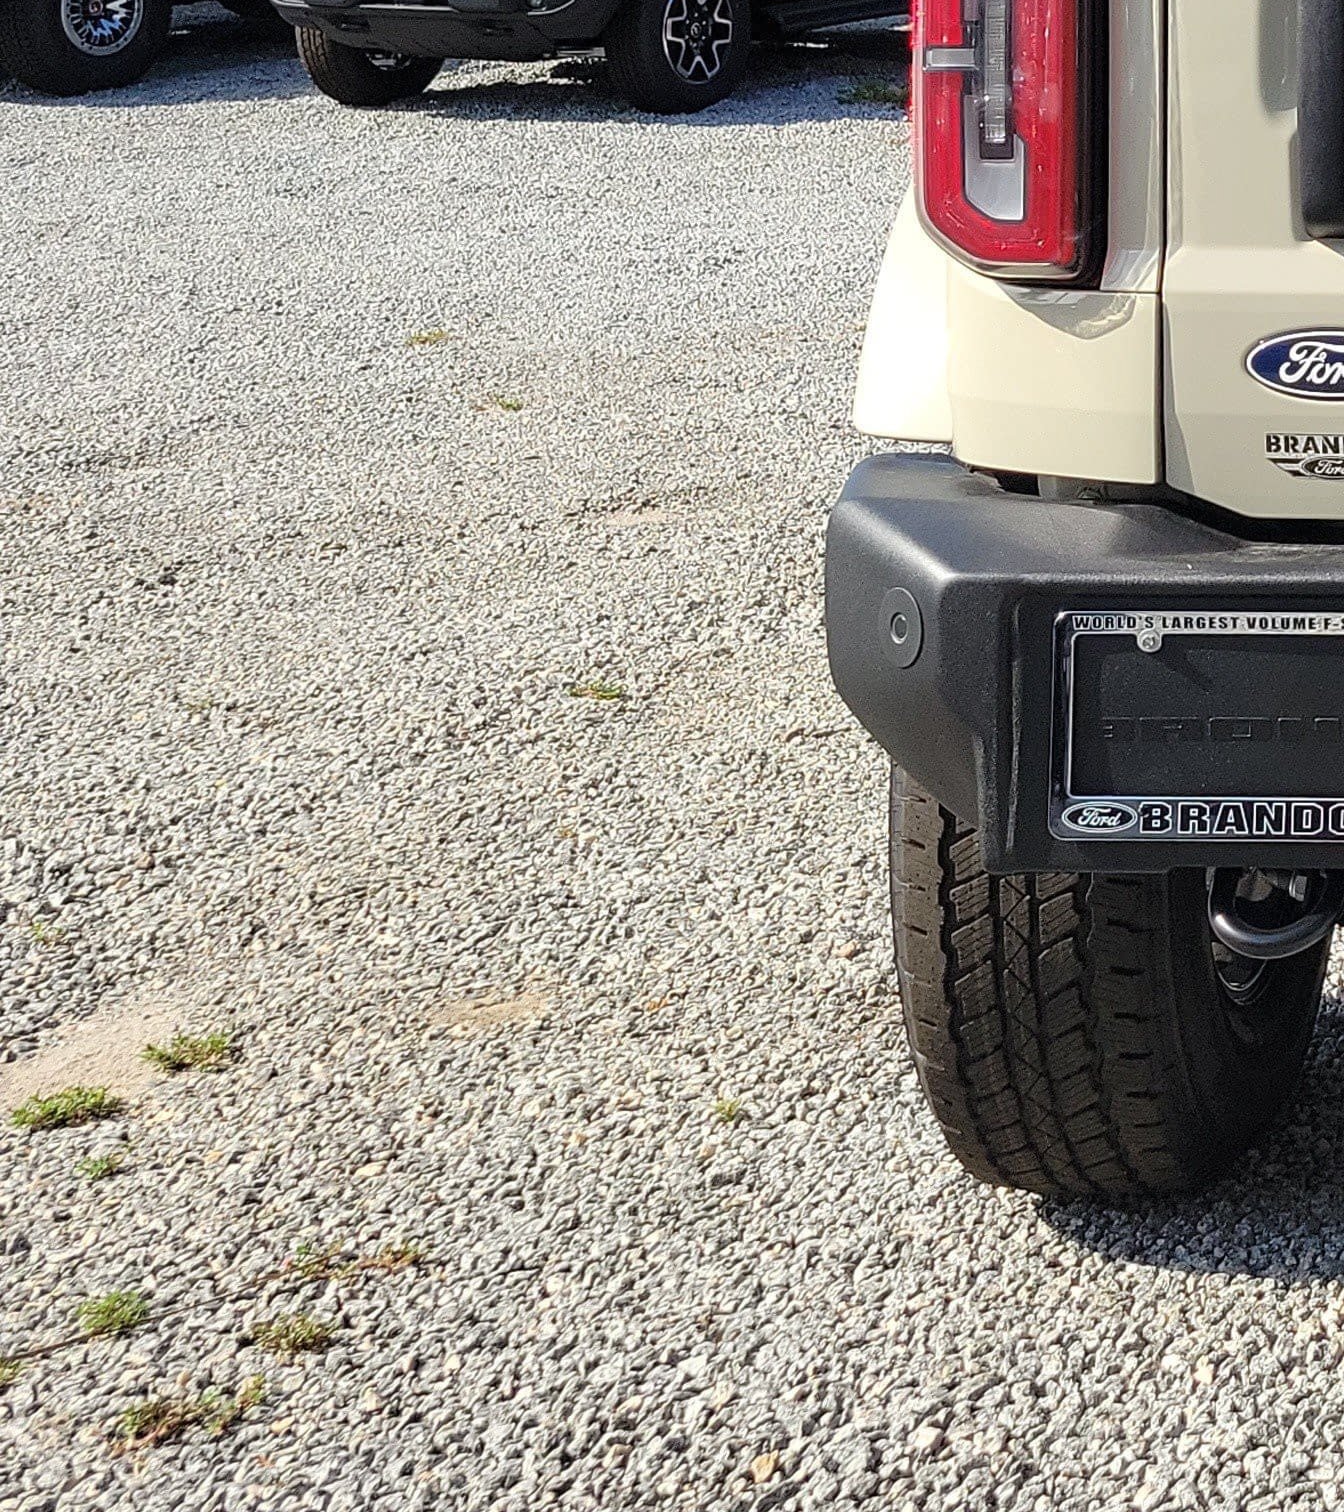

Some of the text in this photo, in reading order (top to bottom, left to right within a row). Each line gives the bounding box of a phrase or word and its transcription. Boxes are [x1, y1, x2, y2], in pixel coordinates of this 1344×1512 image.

[1073, 615, 1154, 631] WORLD'S
[1162, 616, 1239, 630] LARGEST
[1249, 616, 1317, 630] VOLUME
[1078, 807, 1121, 827] Ford
